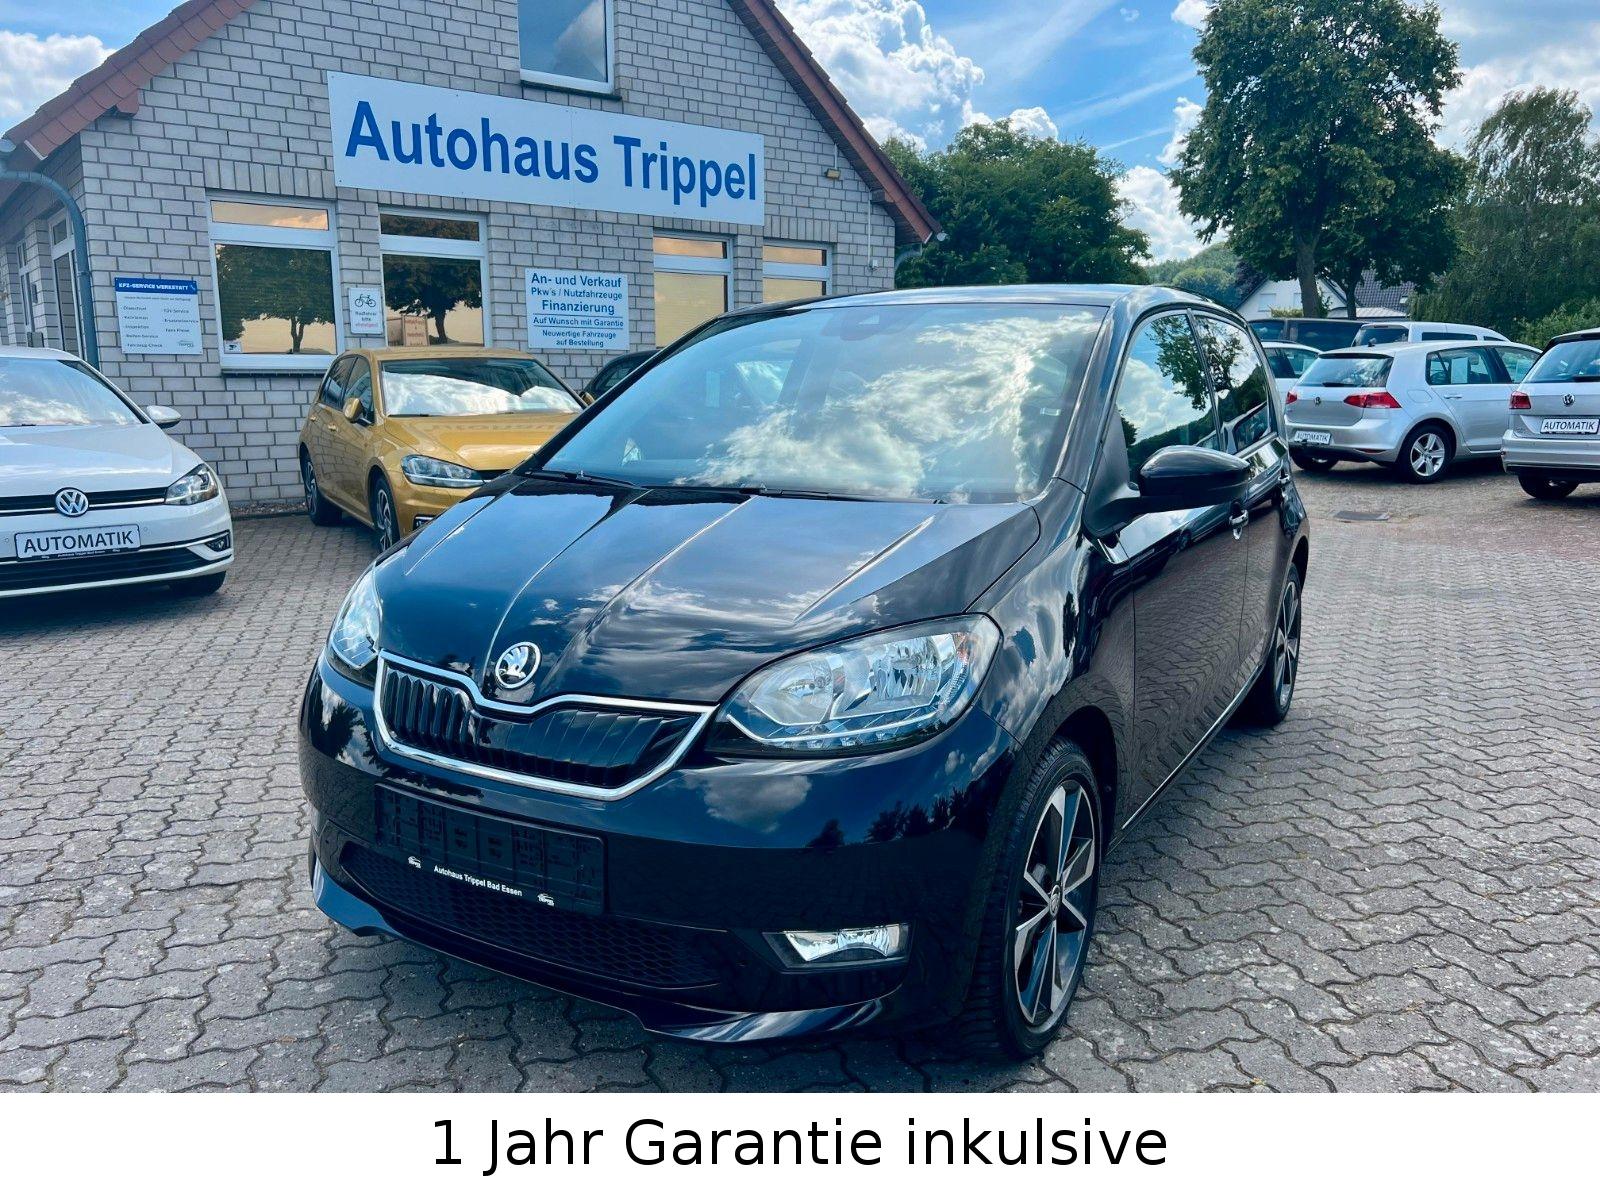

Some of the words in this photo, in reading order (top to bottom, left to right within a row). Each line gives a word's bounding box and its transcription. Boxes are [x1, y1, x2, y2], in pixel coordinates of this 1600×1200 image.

[345, 100, 599, 184] Autohaus
[613, 135, 756, 208] Trippel
[531, 273, 552, 284] An-
[555, 276, 577, 285] und
[580, 276, 622, 288] Verkauf
[563, 290, 623, 301] Nutzfahrzeuge
[542, 300, 615, 315] Finanzierung
[548, 317, 579, 326] Wunsch
[594, 319, 624, 327] Garantie
[542, 330, 581, 339] Neuwertige
[582, 331, 616, 340] Fahrzeuge
[568, 340, 604, 348] Bestellung
[1544, 421, 1595, 430] AUTOMATIK
[23, 530, 134, 553] AUTOMATIK
[434, 865, 463, 880] Autohaus
[464, 874, 486, 887] Trippel
[487, 880, 500, 891] Bad
[501, 884, 523, 897] Essen
